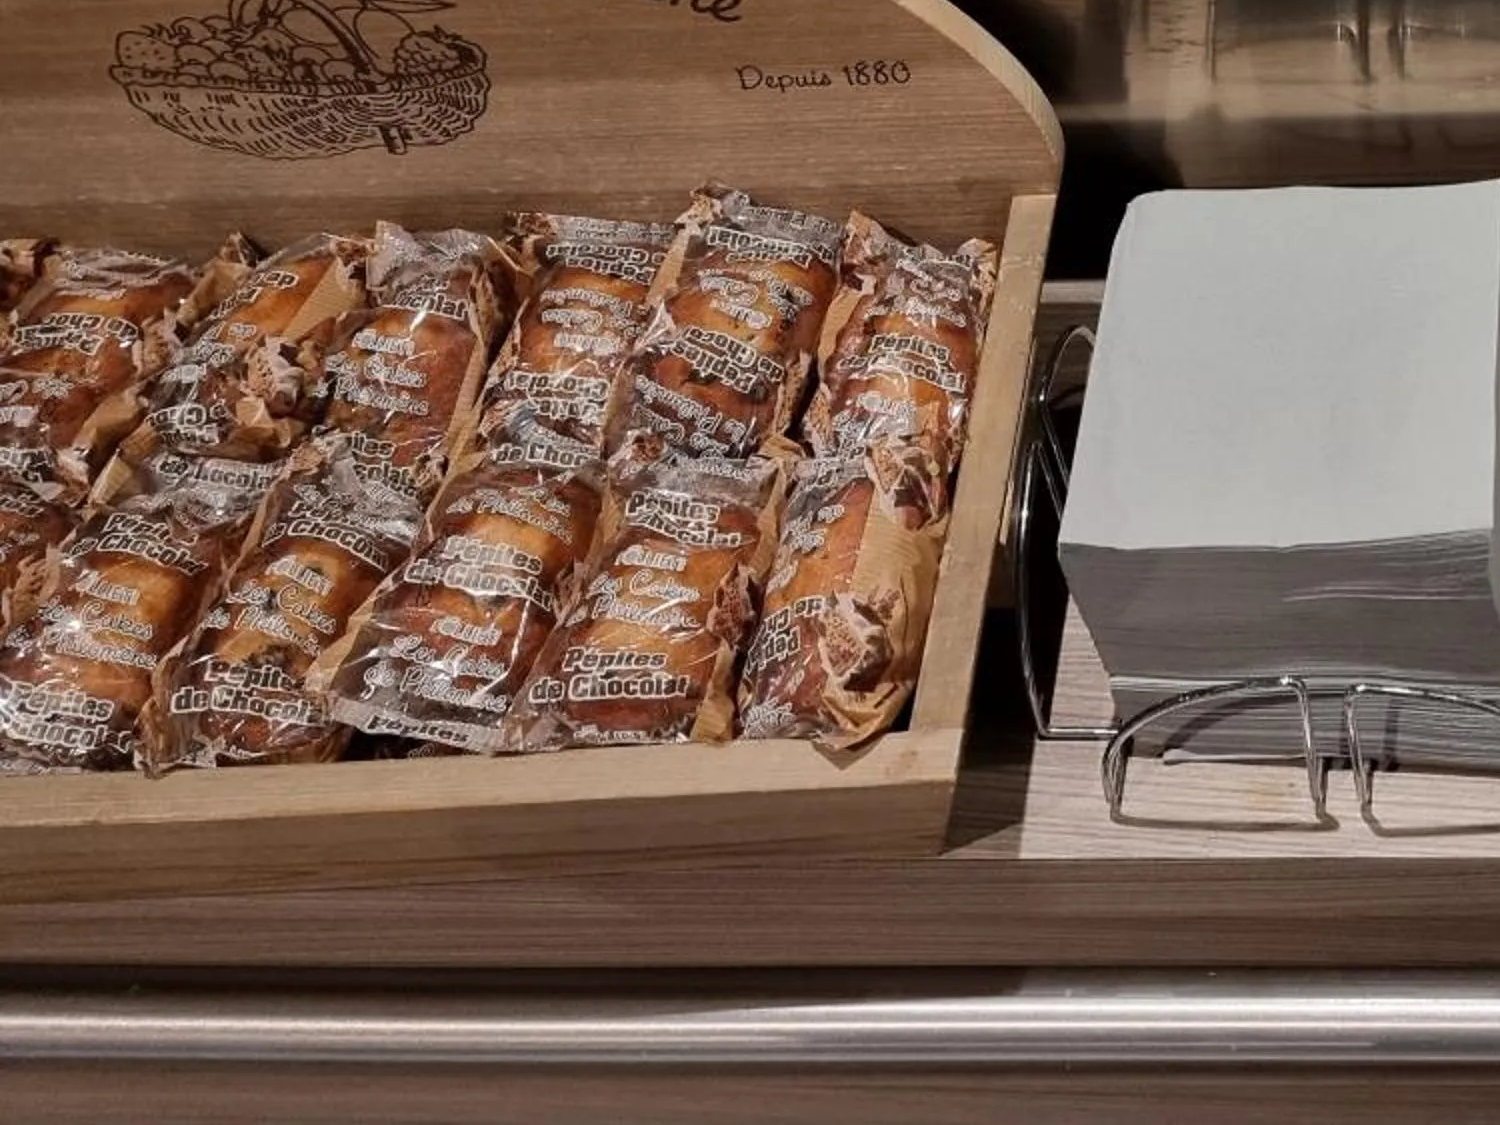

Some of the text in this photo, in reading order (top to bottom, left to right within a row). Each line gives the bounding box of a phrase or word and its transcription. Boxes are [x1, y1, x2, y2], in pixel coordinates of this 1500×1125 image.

[734, 59, 912, 94] Depuis 1880
[562, 646, 669, 673] Pépites
[171, 685, 209, 713] de
[529, 674, 693, 704] de Chocolat
